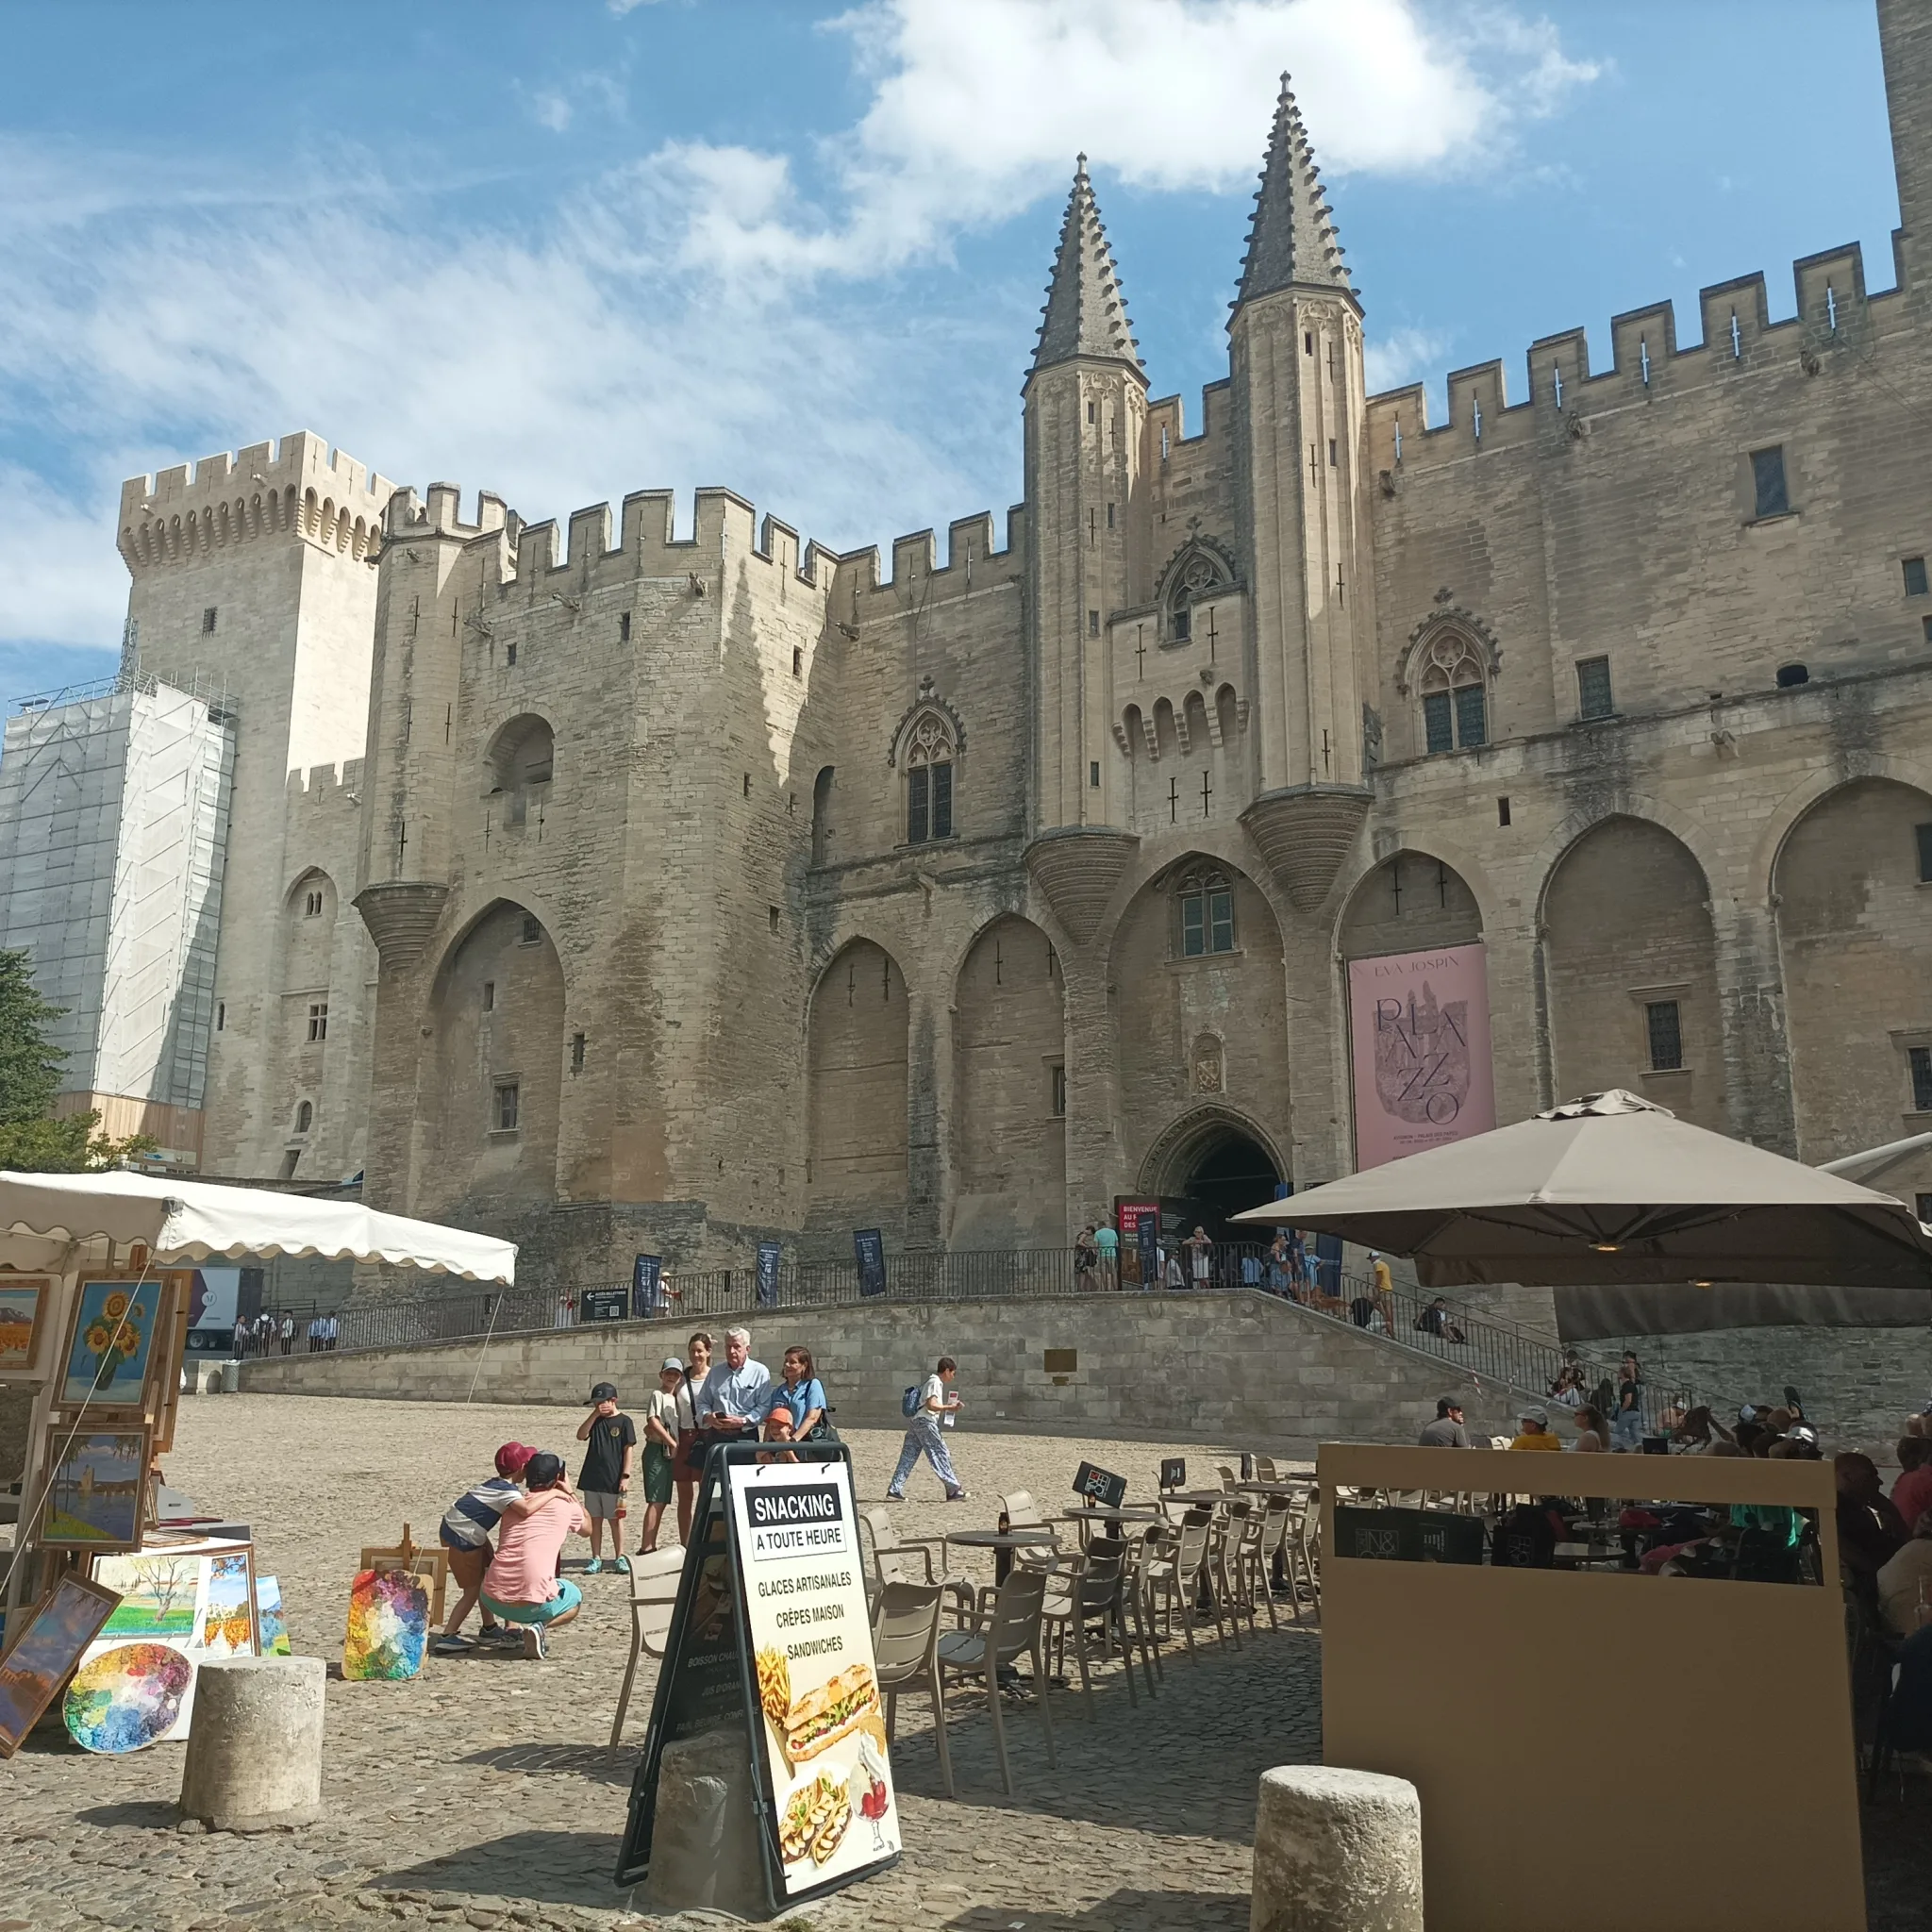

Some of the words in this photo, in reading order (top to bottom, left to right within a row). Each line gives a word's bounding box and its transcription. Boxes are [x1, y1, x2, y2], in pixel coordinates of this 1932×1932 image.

[1374, 962, 1403, 976] EVA
[1408, 955, 1459, 973] JOSPIN
[755, 1493, 835, 1521] SNACKING
[757, 1534, 765, 1551] A
[766, 1530, 805, 1549] TOUTE
[806, 1527, 841, 1545] HEURE
[758, 1577, 794, 1598] GLACES
[795, 1571, 852, 1593] ARTISANALES
[776, 1607, 811, 1628] CRÊPES
[812, 1603, 844, 1623] MAISON
[787, 1635, 843, 1660] SANDWICHES
[687, 1654, 718, 1668] BOISSON
